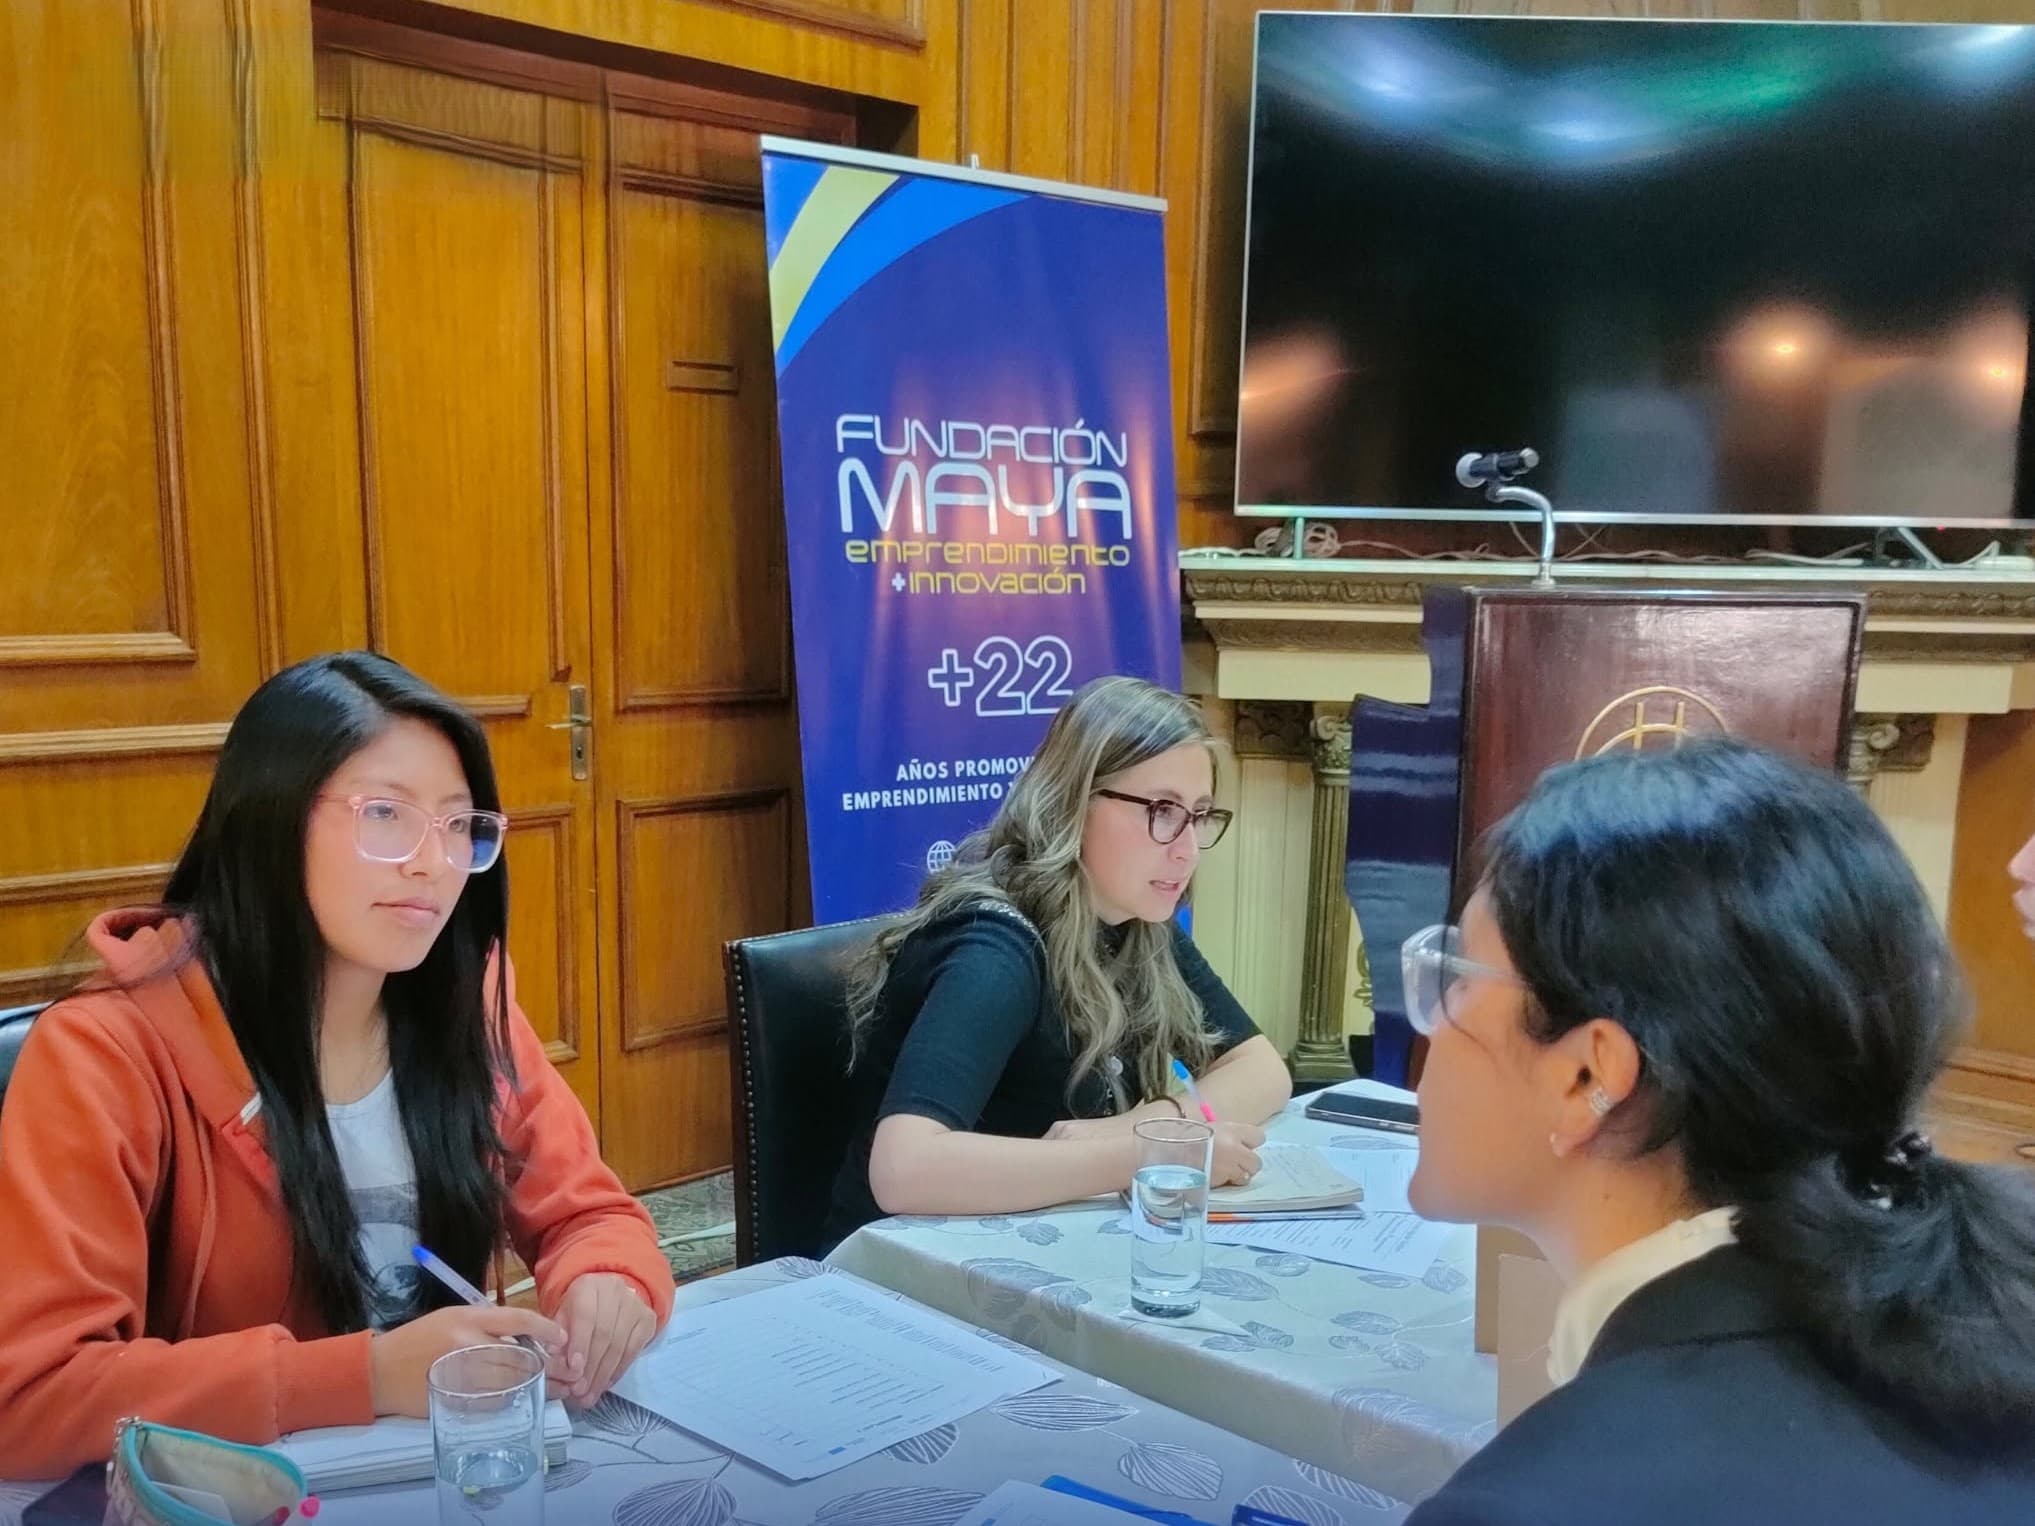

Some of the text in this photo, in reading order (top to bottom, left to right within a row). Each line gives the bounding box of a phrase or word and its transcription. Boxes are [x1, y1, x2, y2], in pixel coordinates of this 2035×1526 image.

[837, 414, 1127, 467] FUNDACIÓN
[838, 457, 1132, 539] MAYA
[845, 540, 1130, 566] emprendimiento
[928, 635, 1074, 717] +22
[896, 756, 1035, 782] AÑOS PROMOV
[842, 782, 1002, 811] EMPRENDIMIENTO
